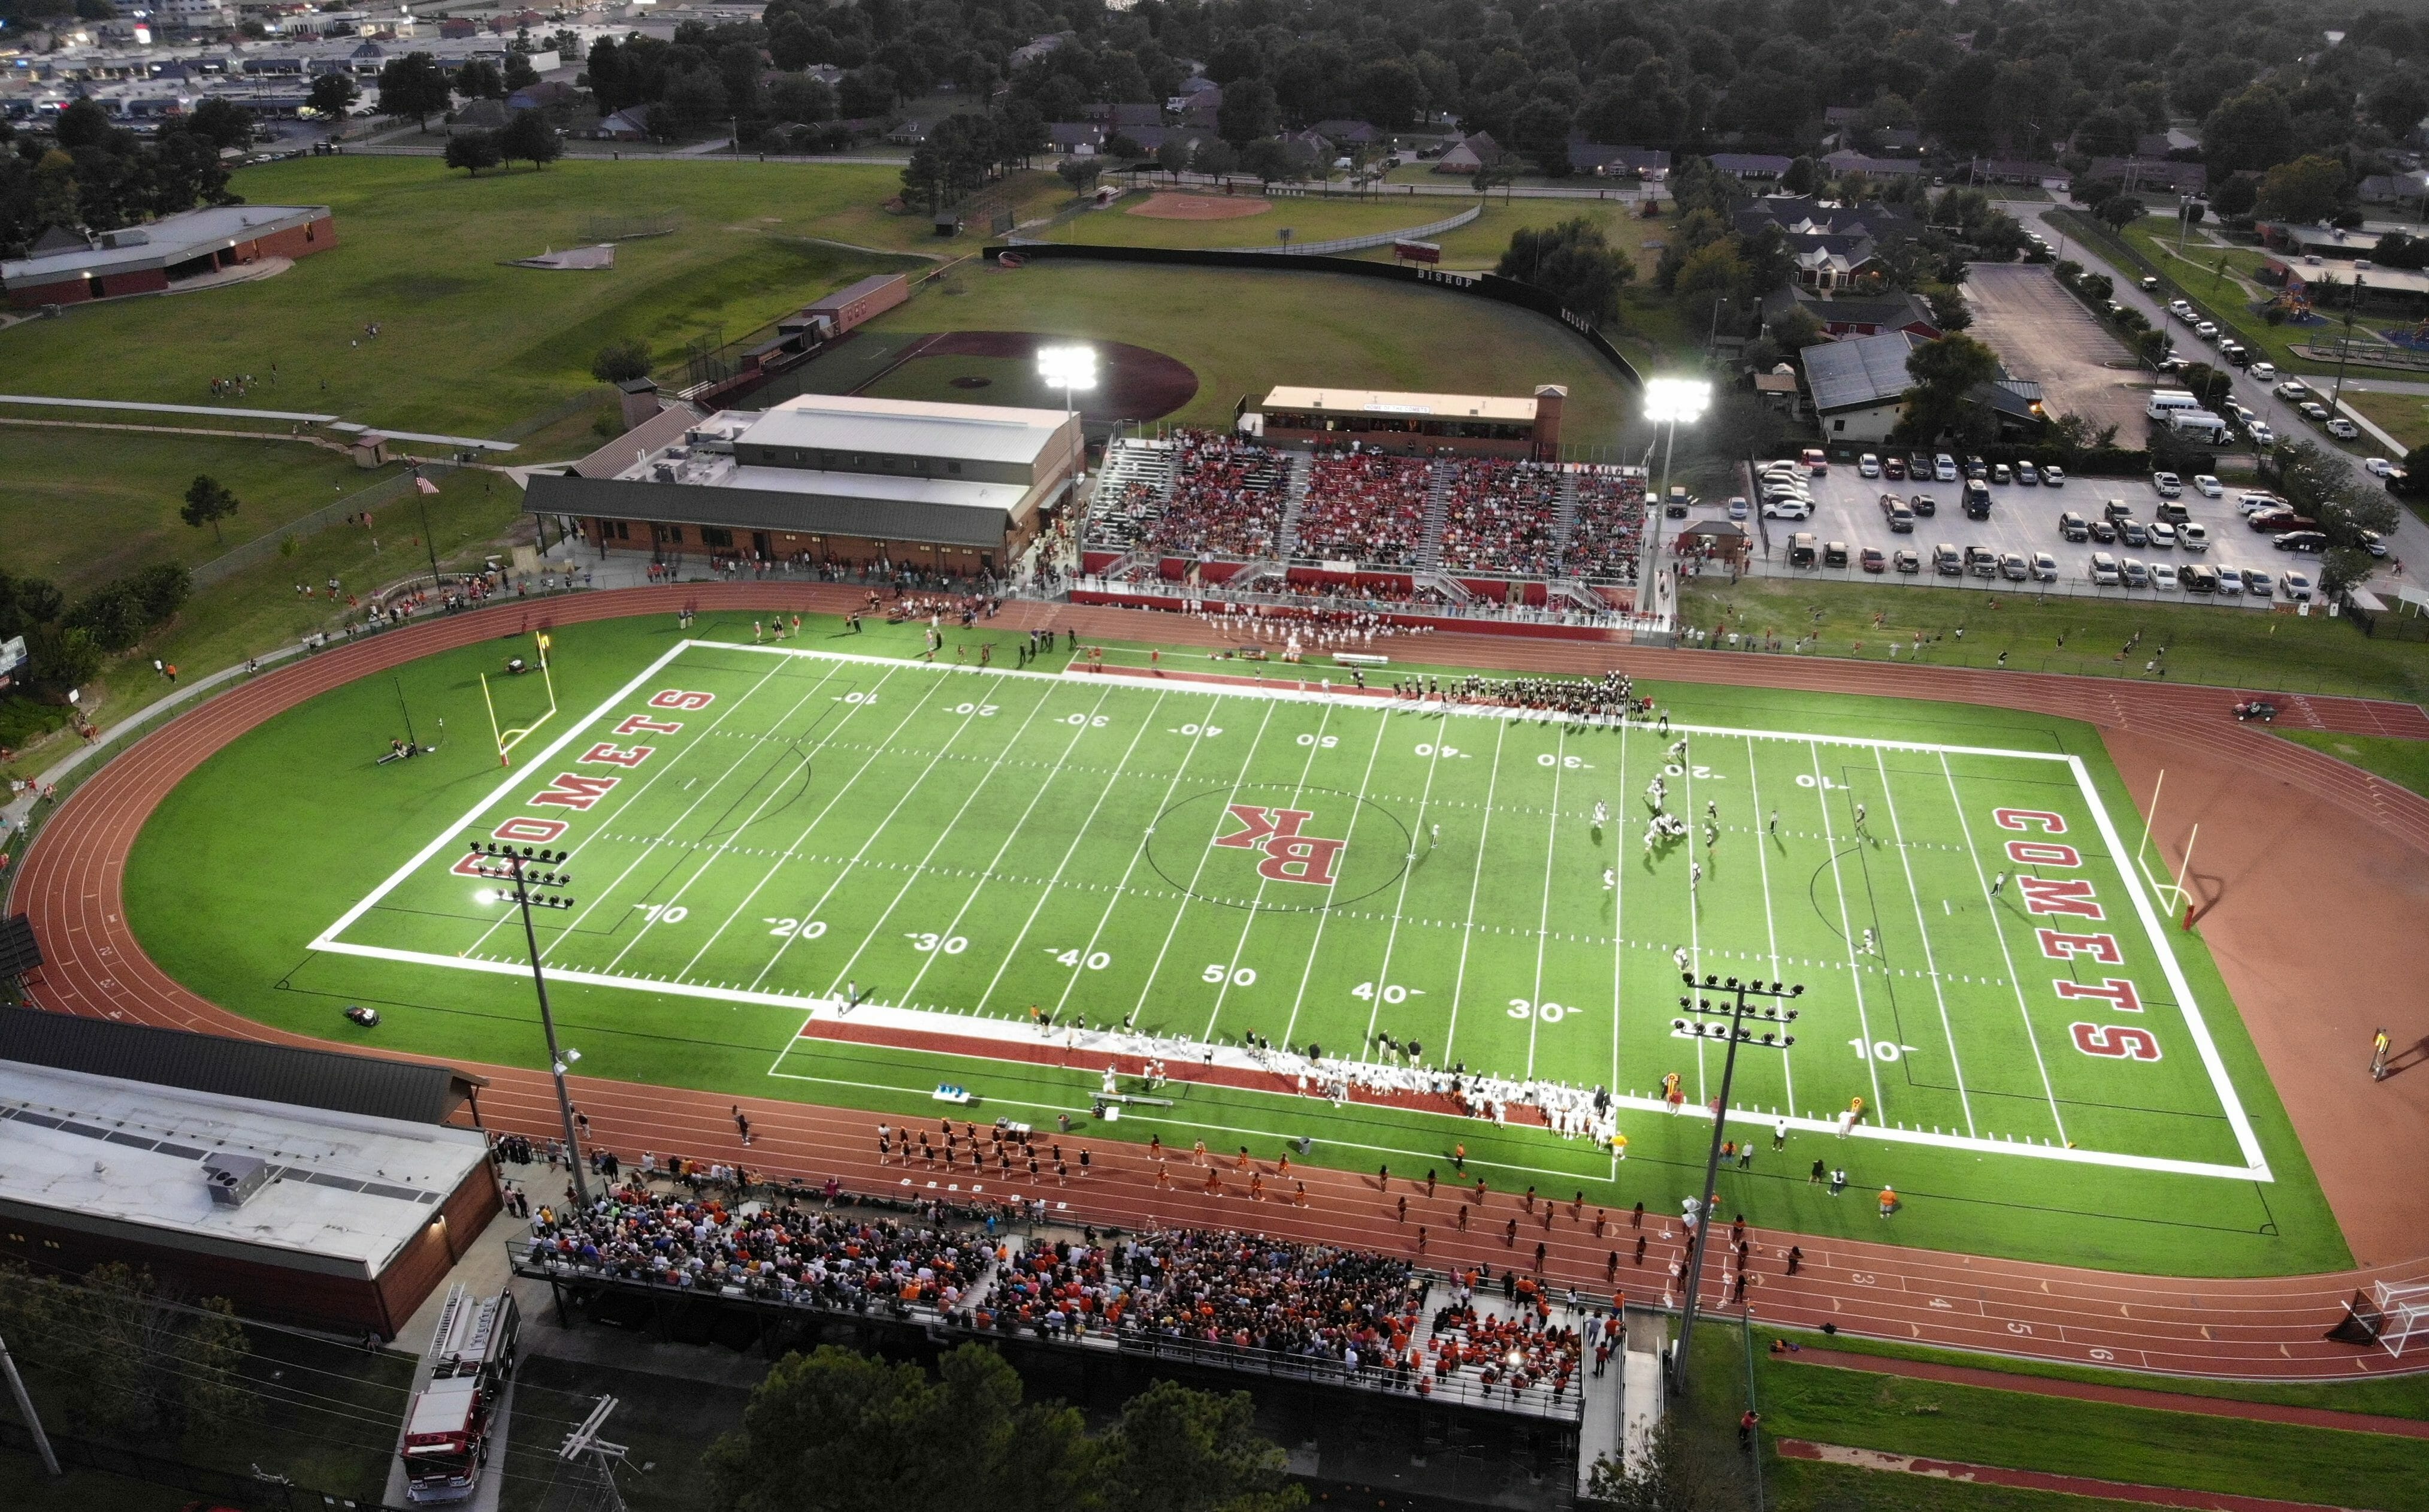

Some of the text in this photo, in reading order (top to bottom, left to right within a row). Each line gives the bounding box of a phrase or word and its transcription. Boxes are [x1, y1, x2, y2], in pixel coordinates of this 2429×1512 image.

[1418, 269, 1472, 287] BISHOP
[1562, 308, 1589, 334] KELLEY
[842, 692, 878, 705] 10
[955, 703, 999, 716] 20
[1066, 713, 1109, 727] 30
[1181, 723, 1223, 737] 40
[1297, 733, 1338, 748] 50
[1415, 743, 1459, 758] 40
[1537, 754, 1582, 768] 30
[1665, 764, 1711, 778] 20
[449, 689, 716, 876] COMETS
[1796, 775, 1834, 789] 10
[645, 905, 688, 924] 10
[770, 918, 827, 939] 20
[1992, 807, 2162, 1062] COMETS
[913, 933, 967, 954] 30
[1056, 949, 1110, 969] 40
[1202, 964, 1256, 986] 50
[1351, 982, 1406, 1003] 40
[1507, 999, 1563, 1022] 30
[1670, 1018, 1730, 1042] 20
[1849, 1038, 1899, 1061] 10
[1852, 1272, 1875, 1286] 3
[1929, 1298, 1953, 1309] 4
[2007, 1323, 2032, 1335] 5
[2089, 1348, 2114, 1362] 6
